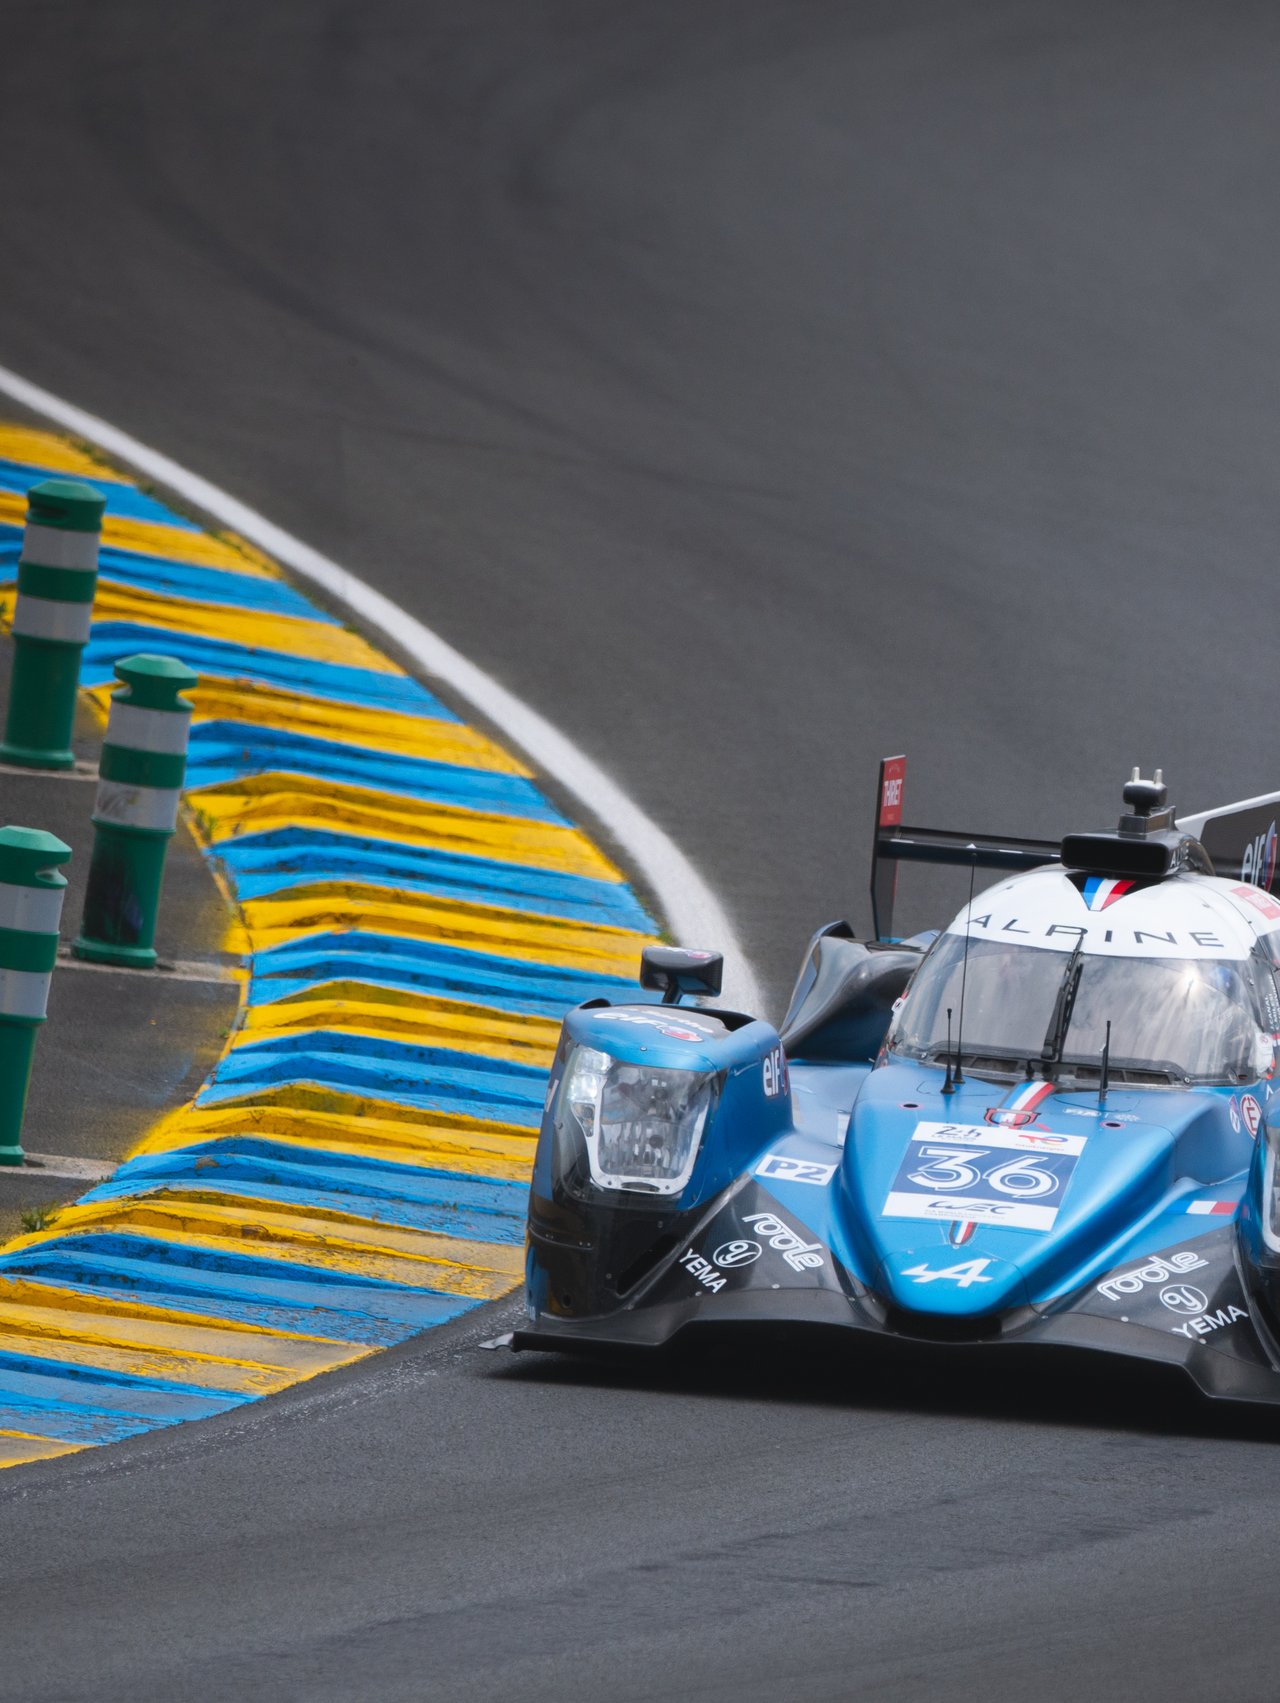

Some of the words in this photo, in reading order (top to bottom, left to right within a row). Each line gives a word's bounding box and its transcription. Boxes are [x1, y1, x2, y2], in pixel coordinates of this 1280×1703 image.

[966, 914, 1225, 948] ALPINE
[763, 1049, 782, 1097] elf
[764, 1159, 829, 1182] P2
[906, 1145, 1060, 1199] 36
[678, 1247, 728, 1294] YEMA
[1171, 1304, 1249, 1340] YEMA
